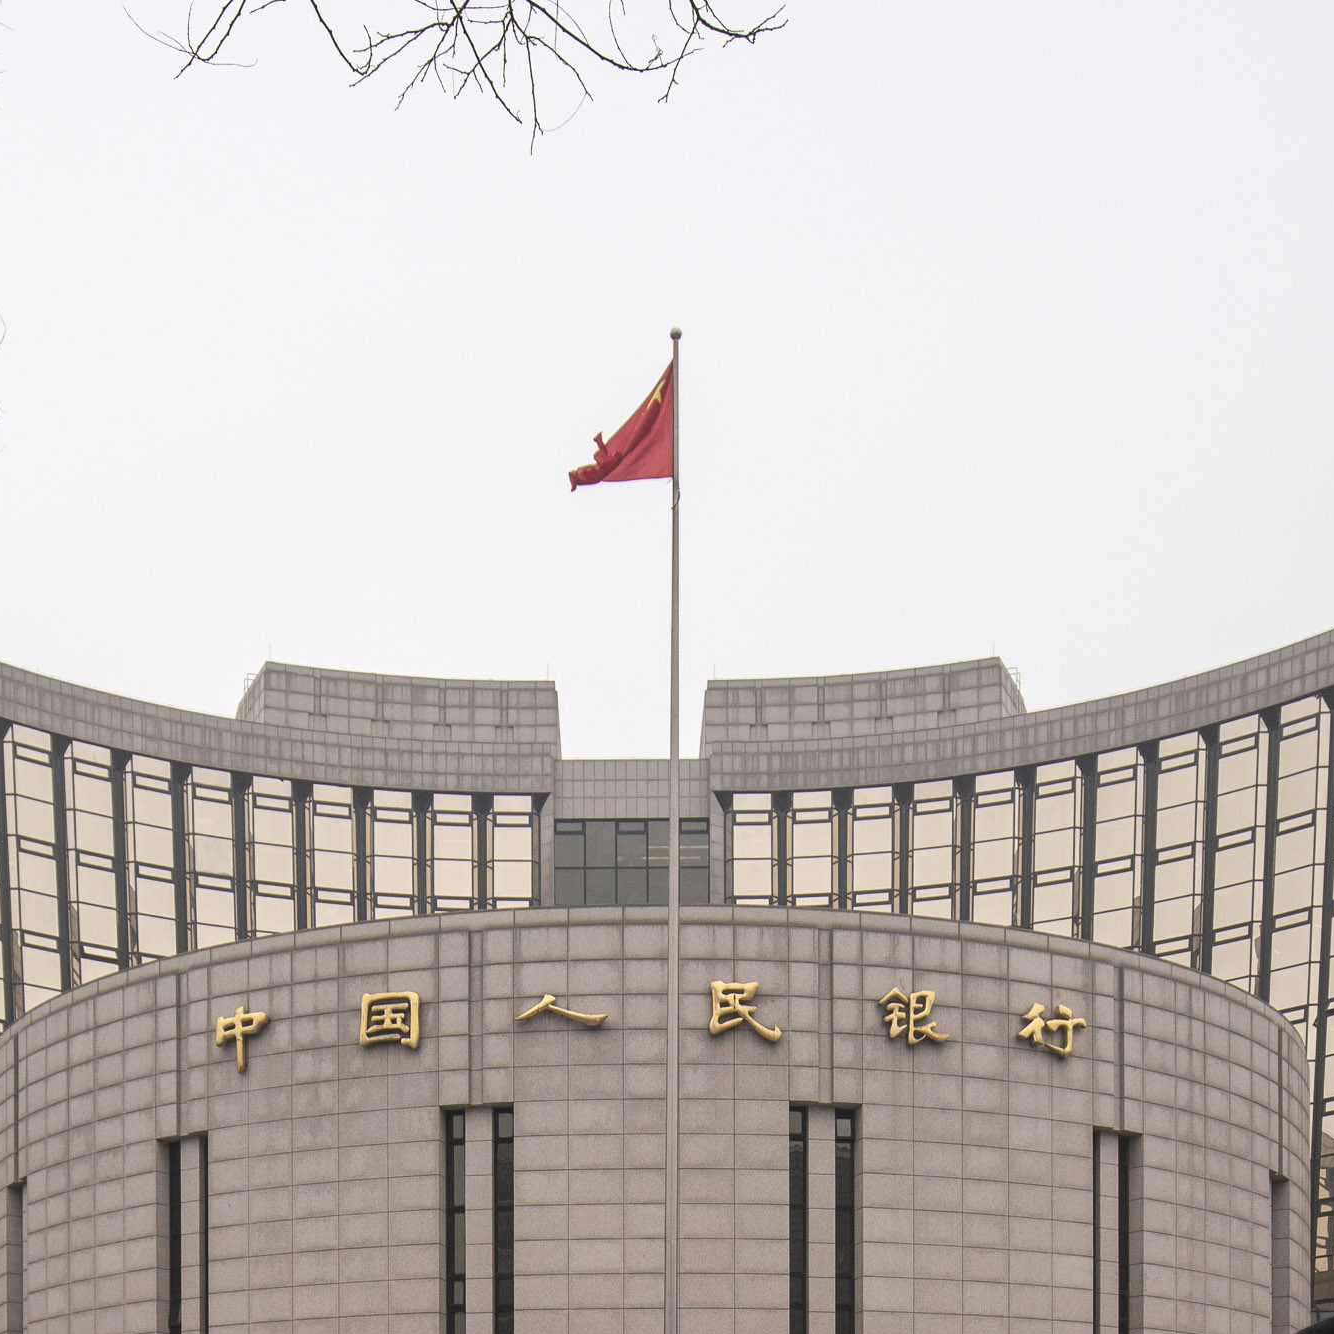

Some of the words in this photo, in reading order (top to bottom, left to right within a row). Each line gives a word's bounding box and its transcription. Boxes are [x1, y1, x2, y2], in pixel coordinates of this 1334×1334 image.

[215, 980, 1087, 1072] 中国人民银行
